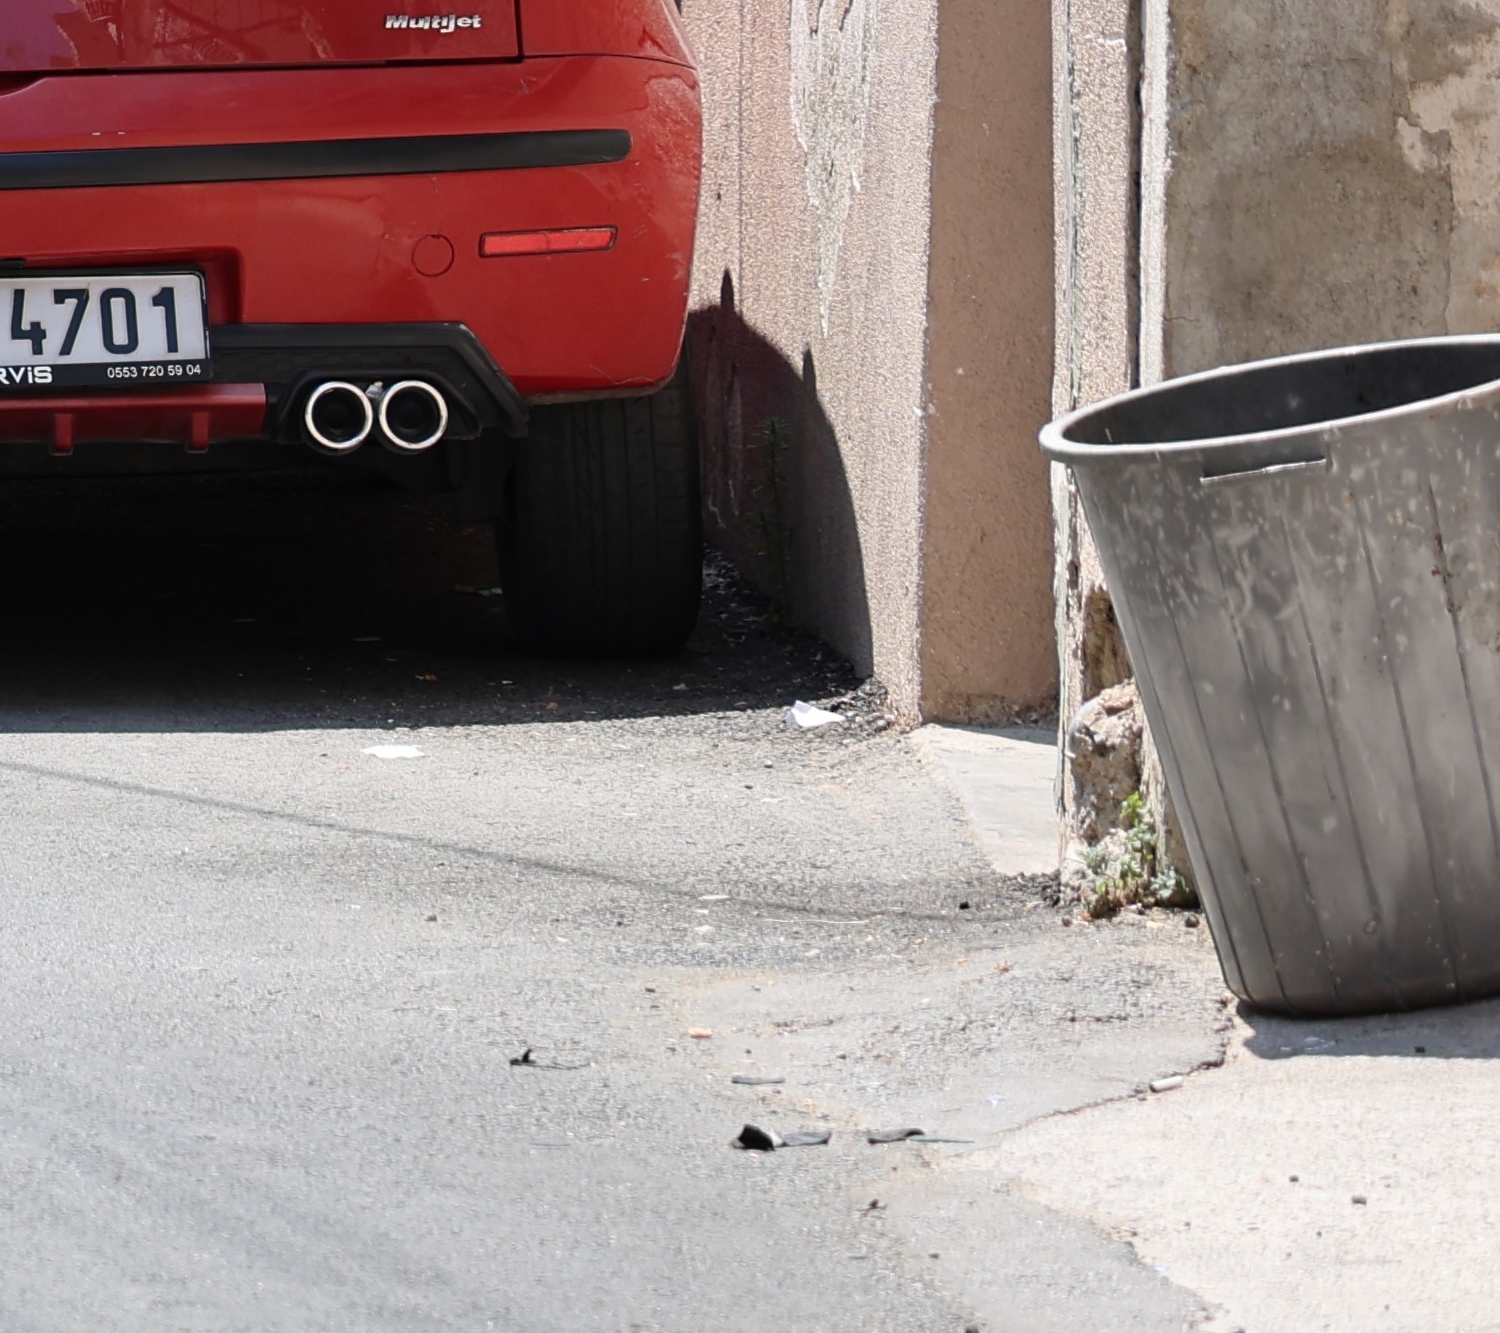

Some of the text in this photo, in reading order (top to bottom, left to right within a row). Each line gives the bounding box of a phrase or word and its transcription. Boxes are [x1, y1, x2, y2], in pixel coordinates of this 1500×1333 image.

[10, 286, 179, 356] 4701
[107, 363, 202, 379] 0553 720 59 04
